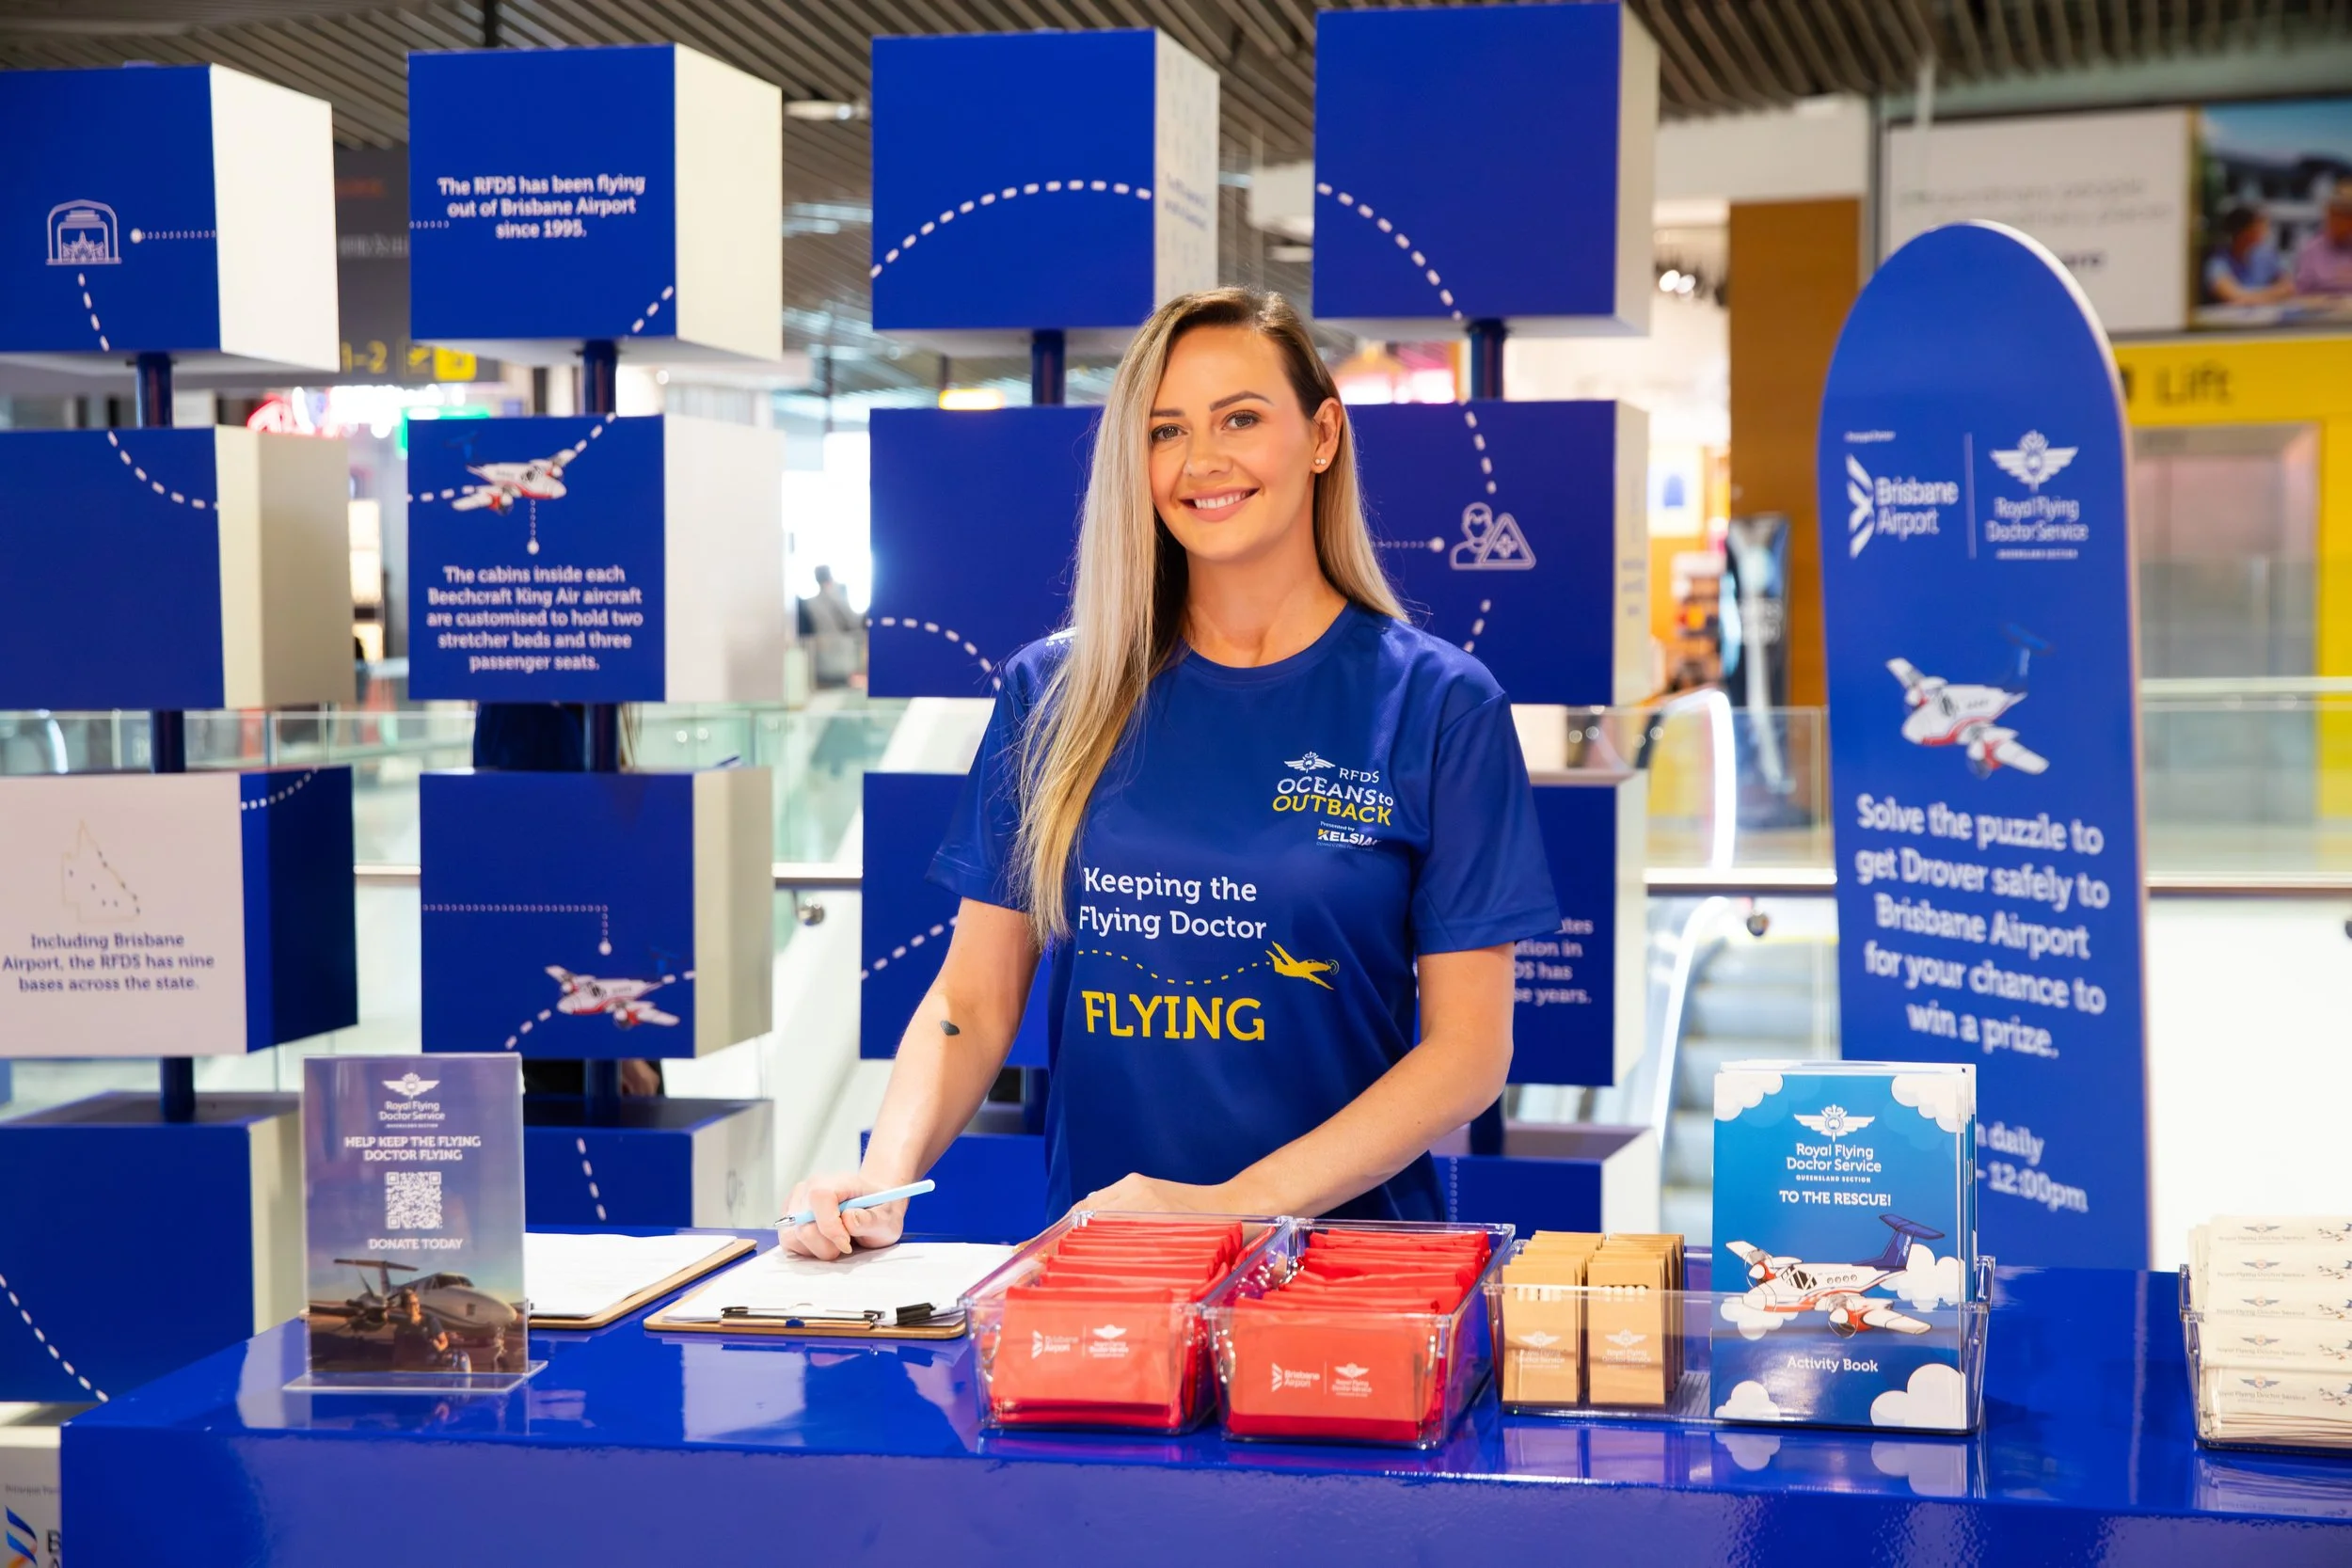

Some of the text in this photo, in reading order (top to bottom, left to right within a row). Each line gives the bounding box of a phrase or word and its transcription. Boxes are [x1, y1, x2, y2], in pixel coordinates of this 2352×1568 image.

[437, 173, 645, 196] The RFDS has been flying
[447, 197, 636, 218] out of Brisbane Airport
[496, 219, 587, 239] since 1995.
[2155, 360, 2233, 407] Lift
[1874, 476, 1959, 505] Brisbane
[1994, 496, 2080, 521] Royal Flying
[1876, 507, 1940, 542] Airport
[1985, 519, 2089, 542] Doctor Service
[442, 564, 626, 583] The cabins inside each
[427, 586, 643, 608] Beechcraft King Air aircraft
[426, 610, 644, 626] are customised to hold two
[437, 631, 632, 649] stretcher beds and three
[469, 654, 599, 673] passenger seats.
[1339, 768, 1380, 784] RFDS
[1277, 776, 1394, 807] OCEANS to
[1273, 794, 1392, 827] OUTBACK
[1320, 821, 1347, 831] Presented
[1856, 794, 2104, 855] Solve the puzzle to
[1084, 867, 1257, 904] Keeping the
[1854, 847, 2110, 912] get Drover safely to
[1079, 906, 1266, 940] Flying Doctor
[1874, 893, 2090, 960] Brisbane Airport
[31, 932, 184, 950] Including Brisbane
[1562, 939, 1583, 958] in
[2, 954, 215, 973] Airport, the RFDS has nine
[1536, 960, 1573, 980] has
[18, 975, 199, 992] bases across the state.
[1864, 940, 2106, 1016] for your chance to
[1534, 988, 1592, 1007] years.
[1082, 990, 1264, 1041] FLYING
[1906, 999, 2059, 1060] win a prize.
[379, 1111, 445, 1120] Doctor Service
[385, 1101, 440, 1112] Royal Flying
[344, 1135, 482, 1148] HELP KEEP THE FLYING
[1987, 1121, 2044, 1166] daily
[363, 1149, 463, 1161] DOCTOR FLYING
[1796, 1143, 1874, 1160] Royal Flying
[1787, 1157, 1882, 1172] Doctor Service
[1796, 1174, 1840, 1182] QUEENSLAND
[1779, 1190, 1891, 1207] TO THE RESCUE!
[368, 1239, 463, 1250] DONATE TODAY
[1787, 1356, 1879, 1373] Activity Book
